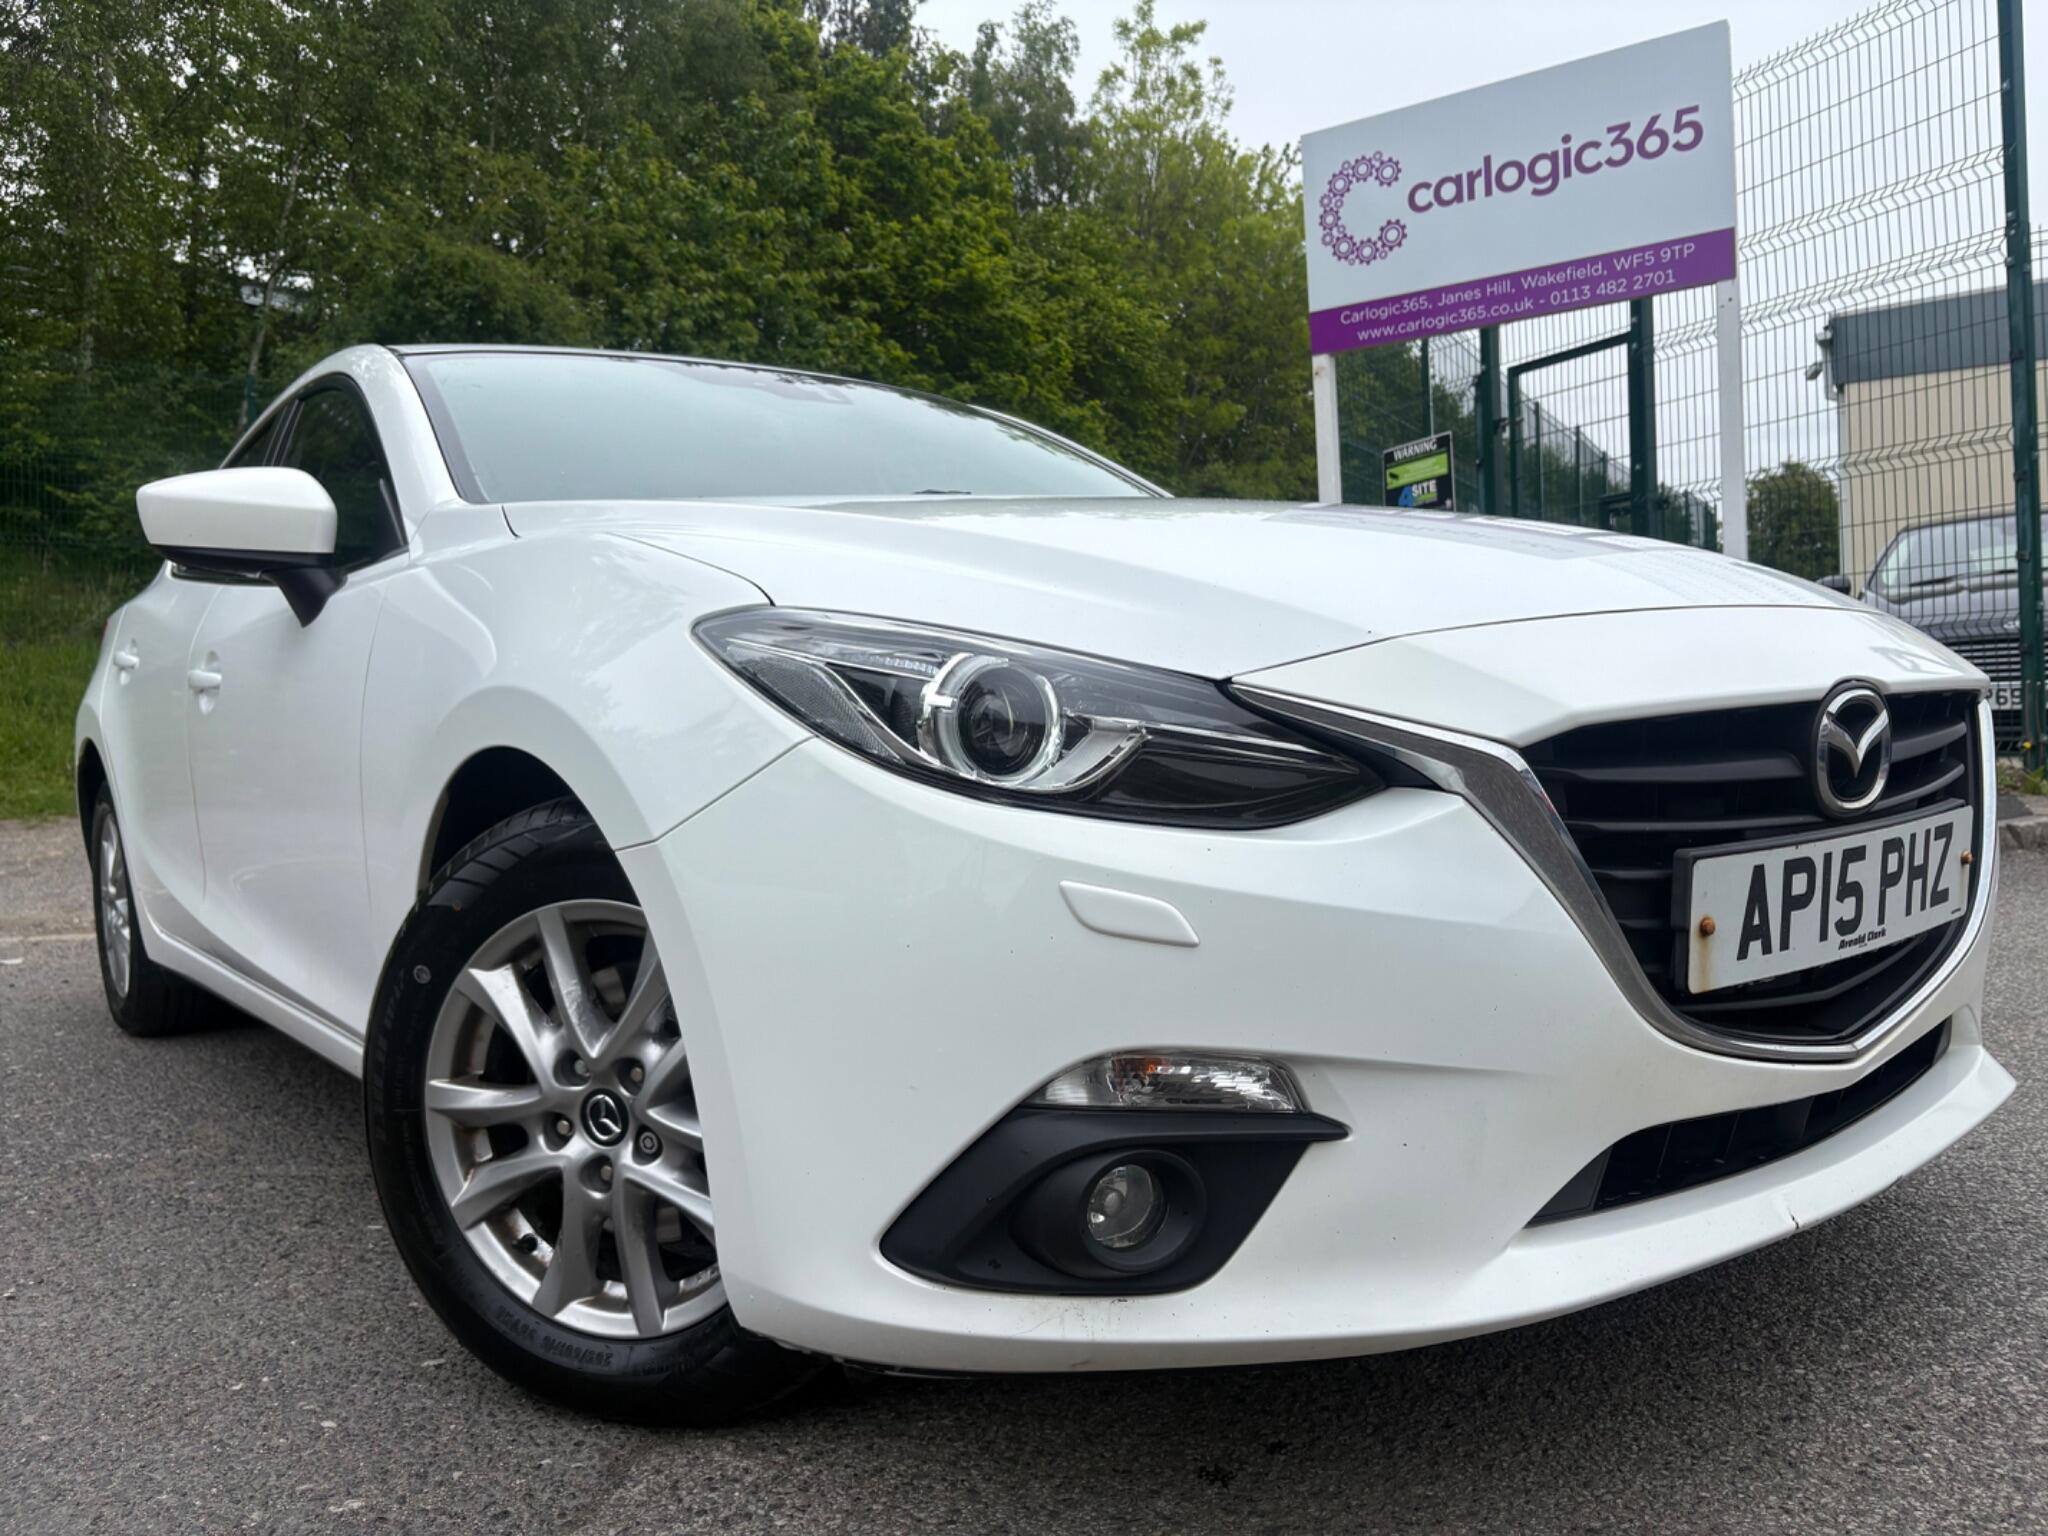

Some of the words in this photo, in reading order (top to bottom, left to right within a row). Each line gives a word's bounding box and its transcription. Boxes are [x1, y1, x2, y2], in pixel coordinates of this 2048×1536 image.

[1407, 105, 1704, 213] carlogic365
[1357, 297, 1534, 341] www.carlogic365.co.uk
[1550, 286, 1591, 305] 0113
[1596, 279, 1628, 297] 482
[1633, 269, 1676, 290] 2701
[1437, 288, 1481, 307] Janes
[1486, 280, 1516, 296] Hill,
[1521, 261, 1607, 290] Wakefield,
[1613, 251, 1655, 271] WF5
[1660, 242, 1696, 263] 9TP
[1394, 440, 1437, 460] WARNING
[1736, 845, 1867, 961] AP15
[1877, 822, 1954, 927] PHZ
